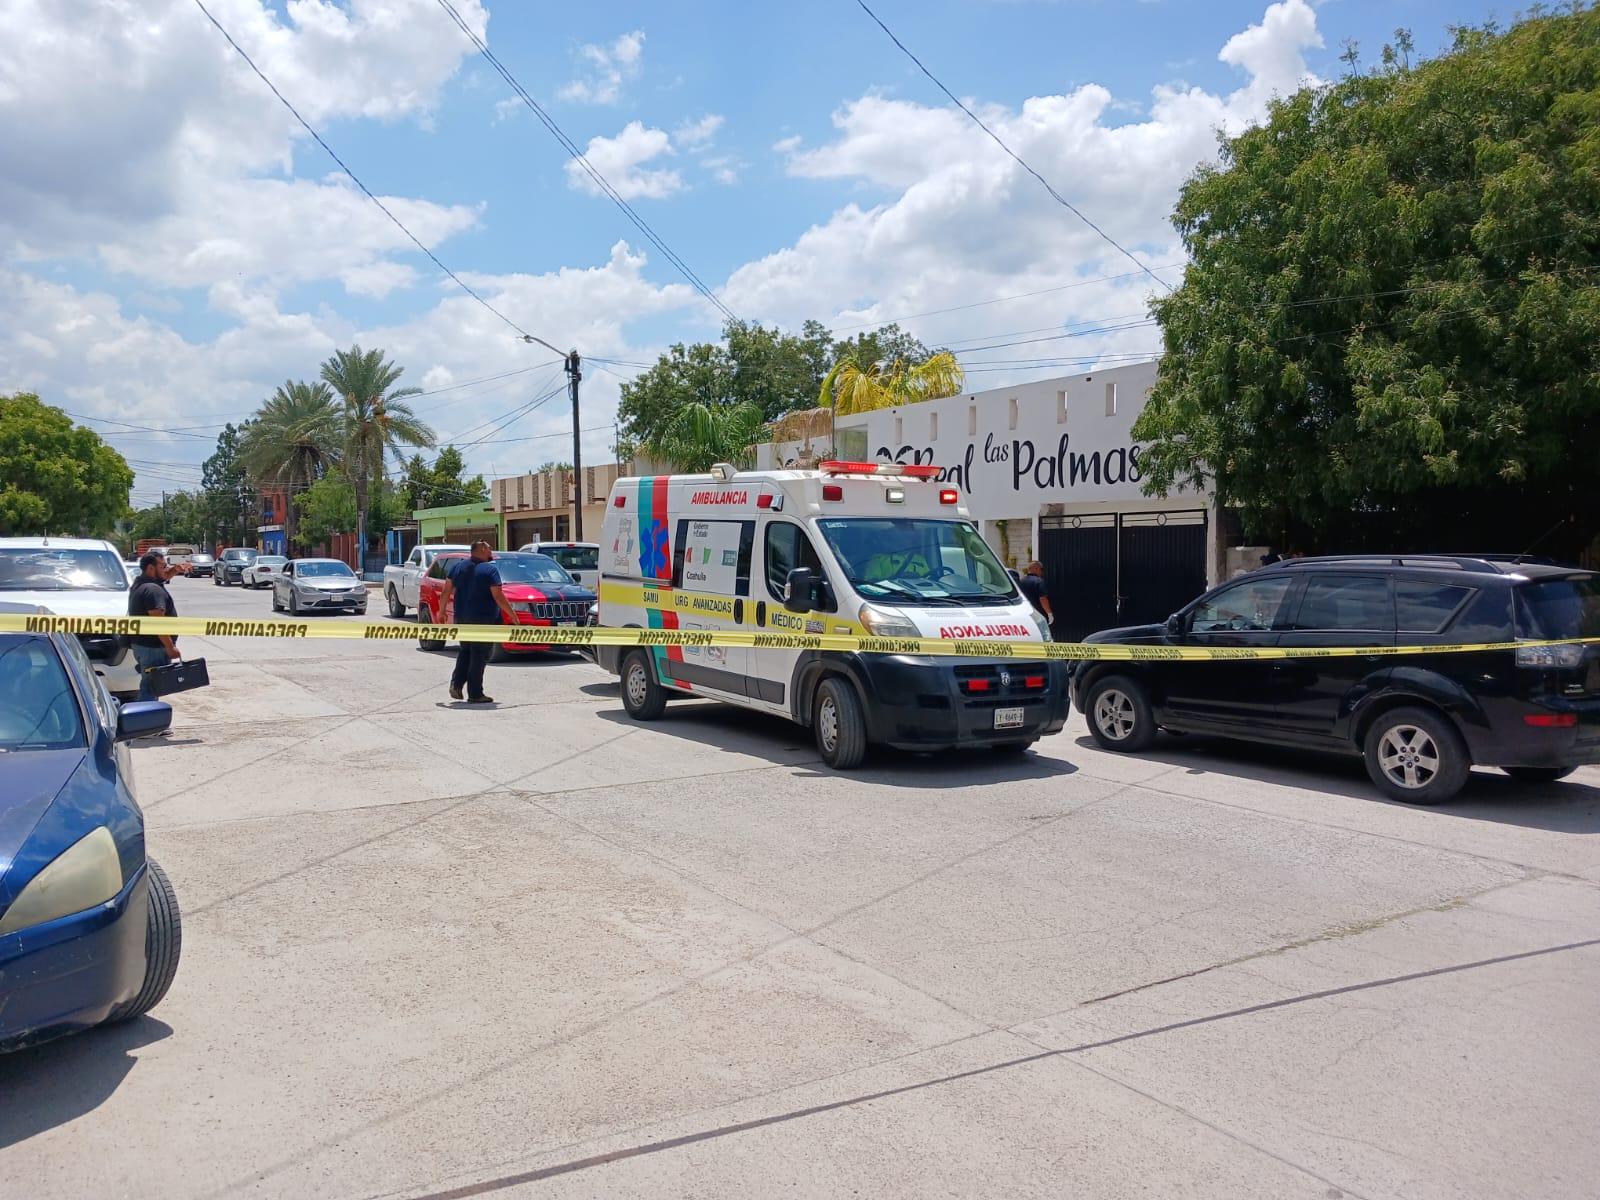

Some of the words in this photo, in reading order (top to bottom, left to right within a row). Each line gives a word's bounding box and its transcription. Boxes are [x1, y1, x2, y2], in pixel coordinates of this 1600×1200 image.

[984, 432, 1009, 464] las
[1012, 432, 1143, 491] Palmas
[691, 491, 747, 505] AMBULANCIA
[643, 591, 659, 604] SAMU
[674, 594, 689, 608] URG
[692, 596, 732, 614] AVANZADAS
[771, 611, 802, 631] MÉDICO
